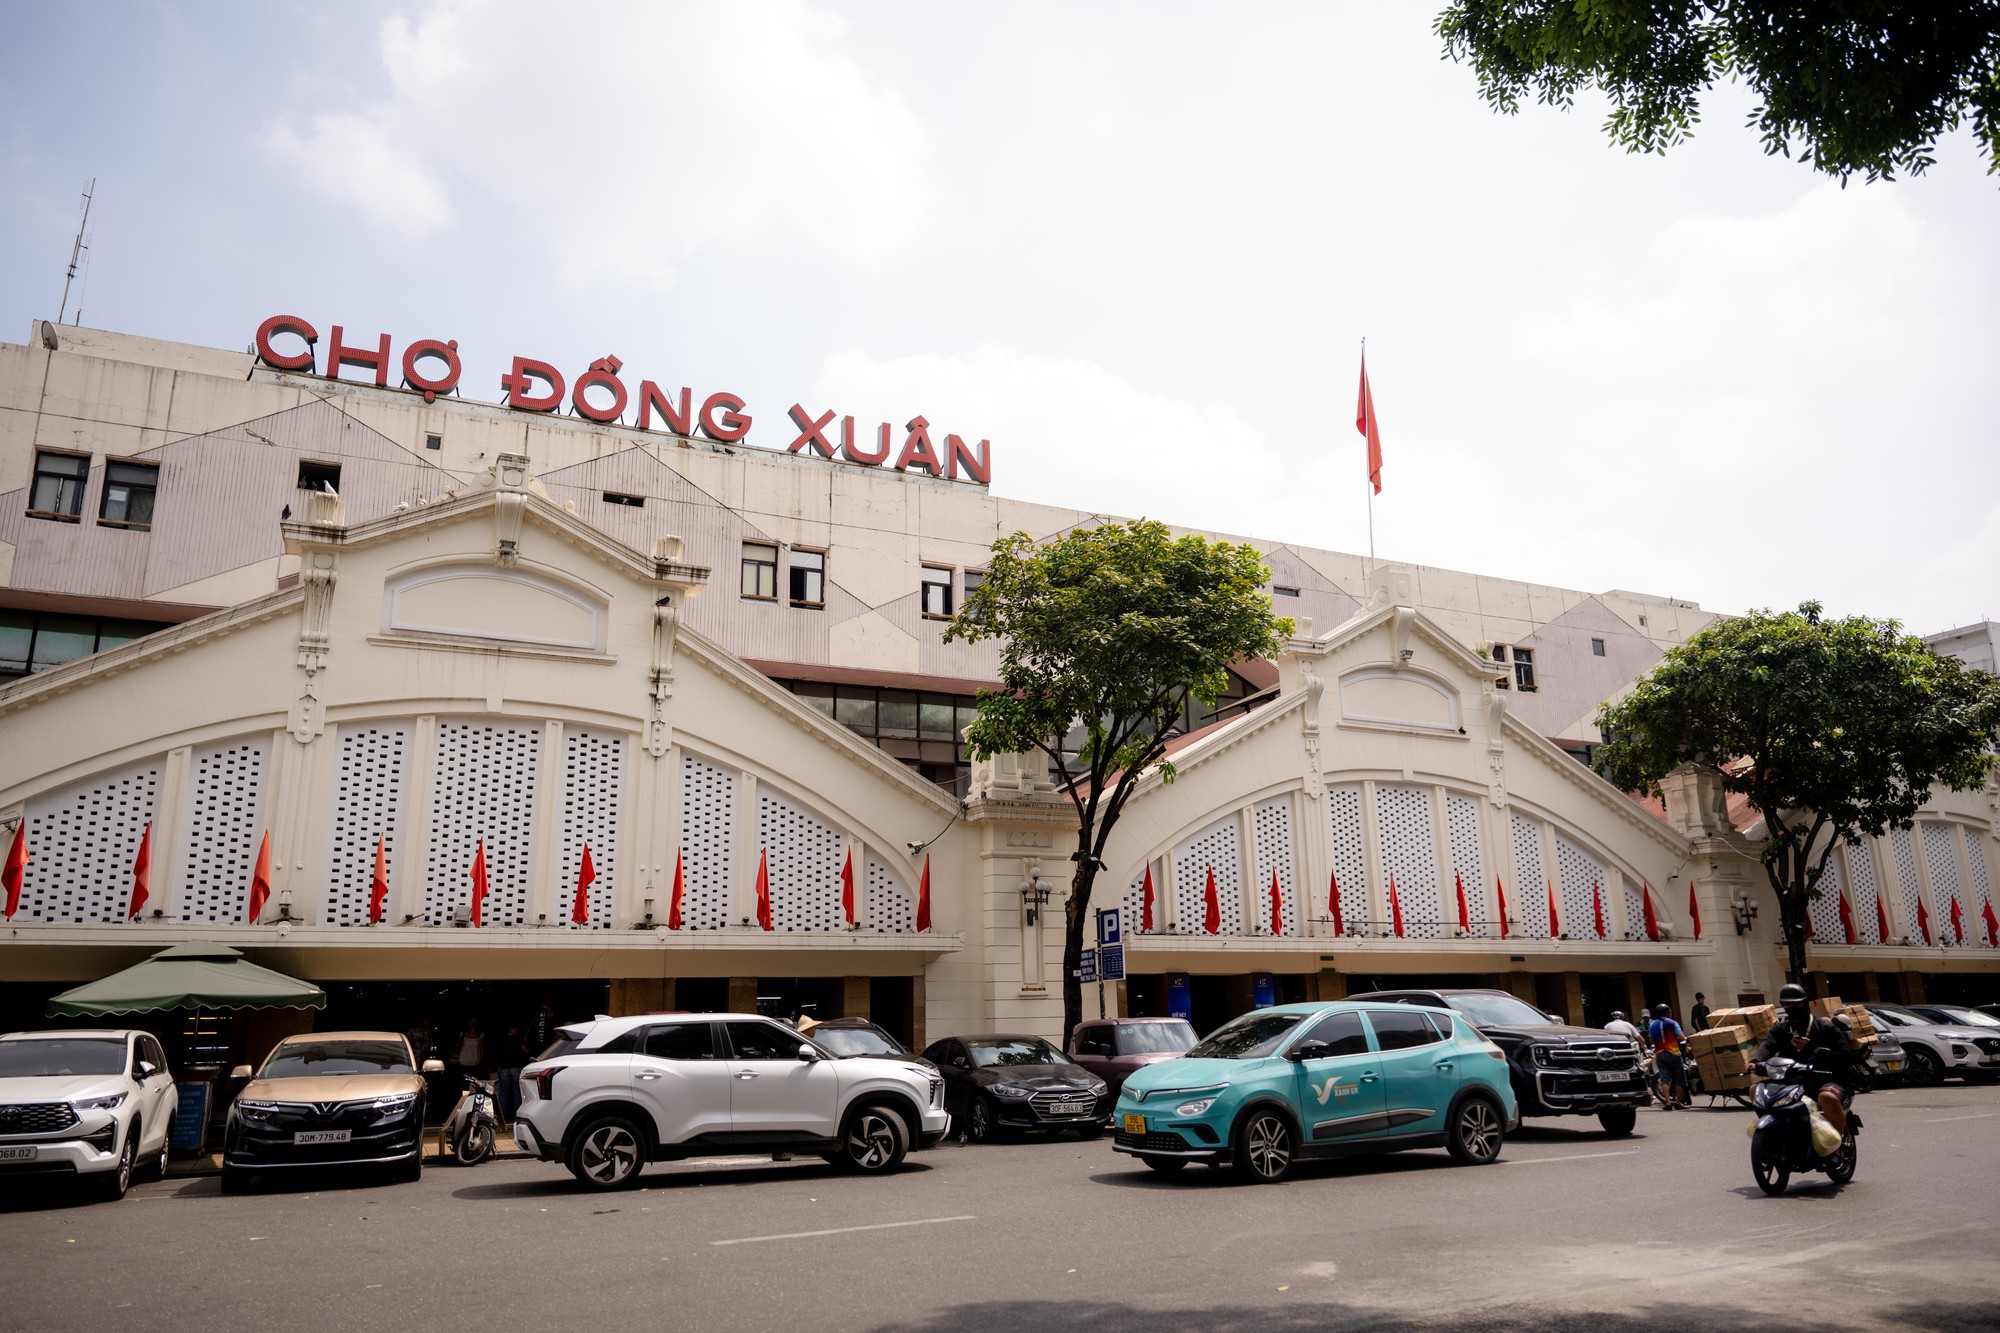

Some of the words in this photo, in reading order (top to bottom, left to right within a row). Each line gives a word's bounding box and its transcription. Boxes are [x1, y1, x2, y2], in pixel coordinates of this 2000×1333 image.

[256, 314, 462, 403] CHỢ
[501, 353, 752, 442] ĐỒNG
[787, 403, 992, 484] XUÂN
[1103, 913, 1118, 942] P
